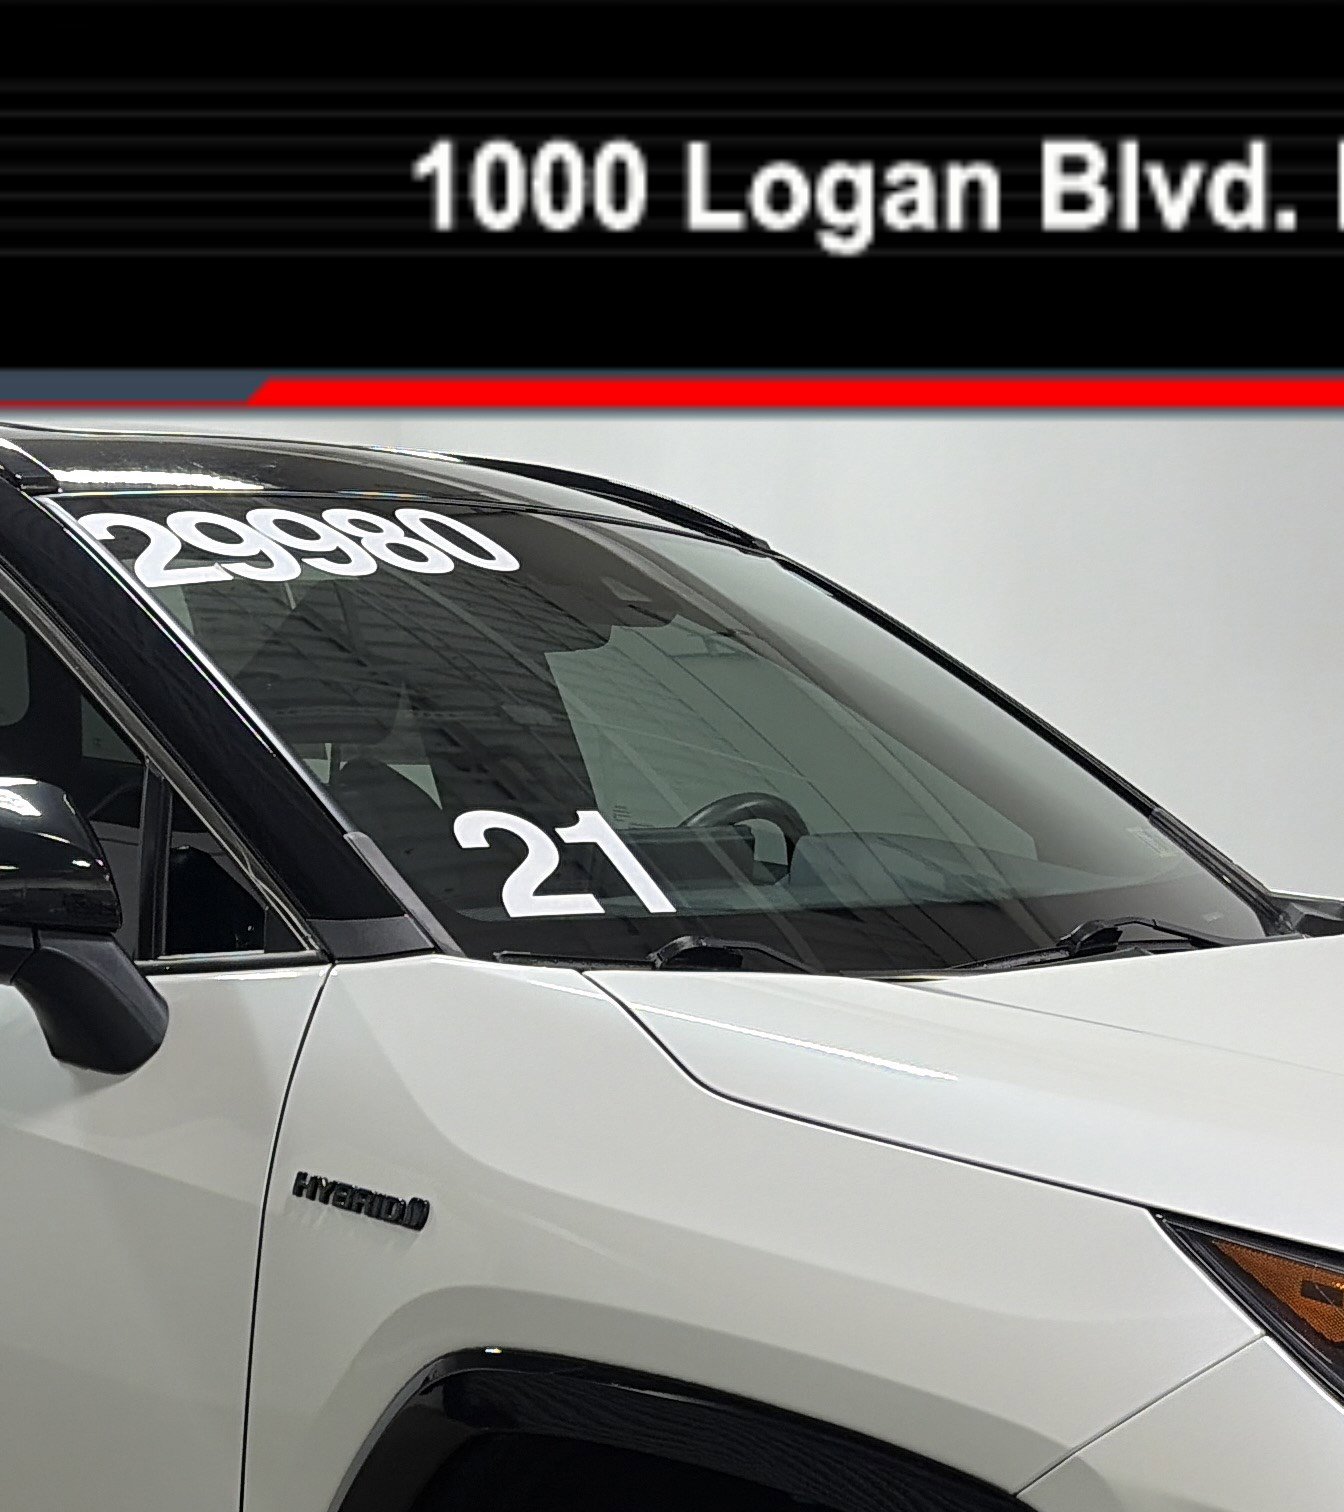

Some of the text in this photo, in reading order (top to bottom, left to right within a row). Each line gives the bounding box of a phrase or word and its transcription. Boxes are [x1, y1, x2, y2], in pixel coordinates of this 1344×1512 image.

[77, 508, 521, 588] 29980
[453, 810, 677, 918] 21
[292, 1171, 408, 1227] HYBRID
